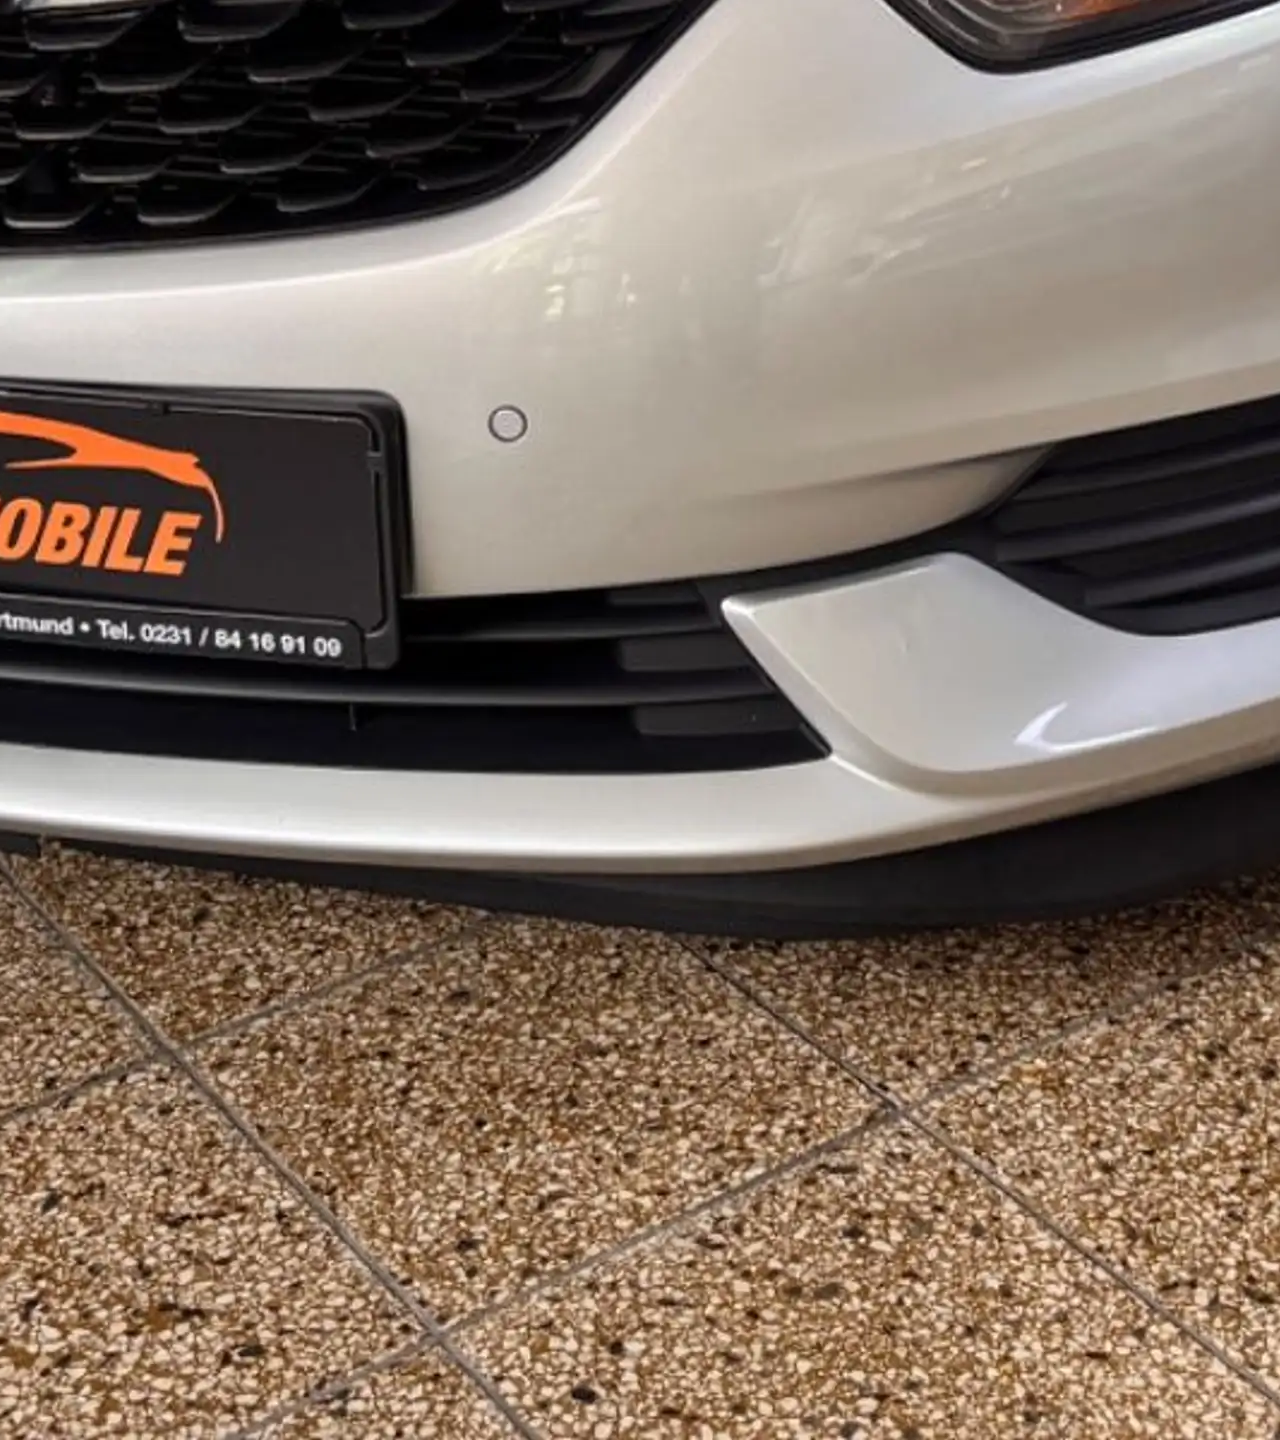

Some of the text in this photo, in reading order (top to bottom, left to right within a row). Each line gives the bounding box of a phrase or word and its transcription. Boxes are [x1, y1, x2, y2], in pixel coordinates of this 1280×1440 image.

[96, 619, 135, 642] Tel.
[140, 623, 192, 647] 0231
[198, 626, 209, 648] /
[214, 629, 243, 650] 84
[249, 632, 277, 653] 16
[280, 634, 306, 655] 91
[313, 636, 343, 658] 09
